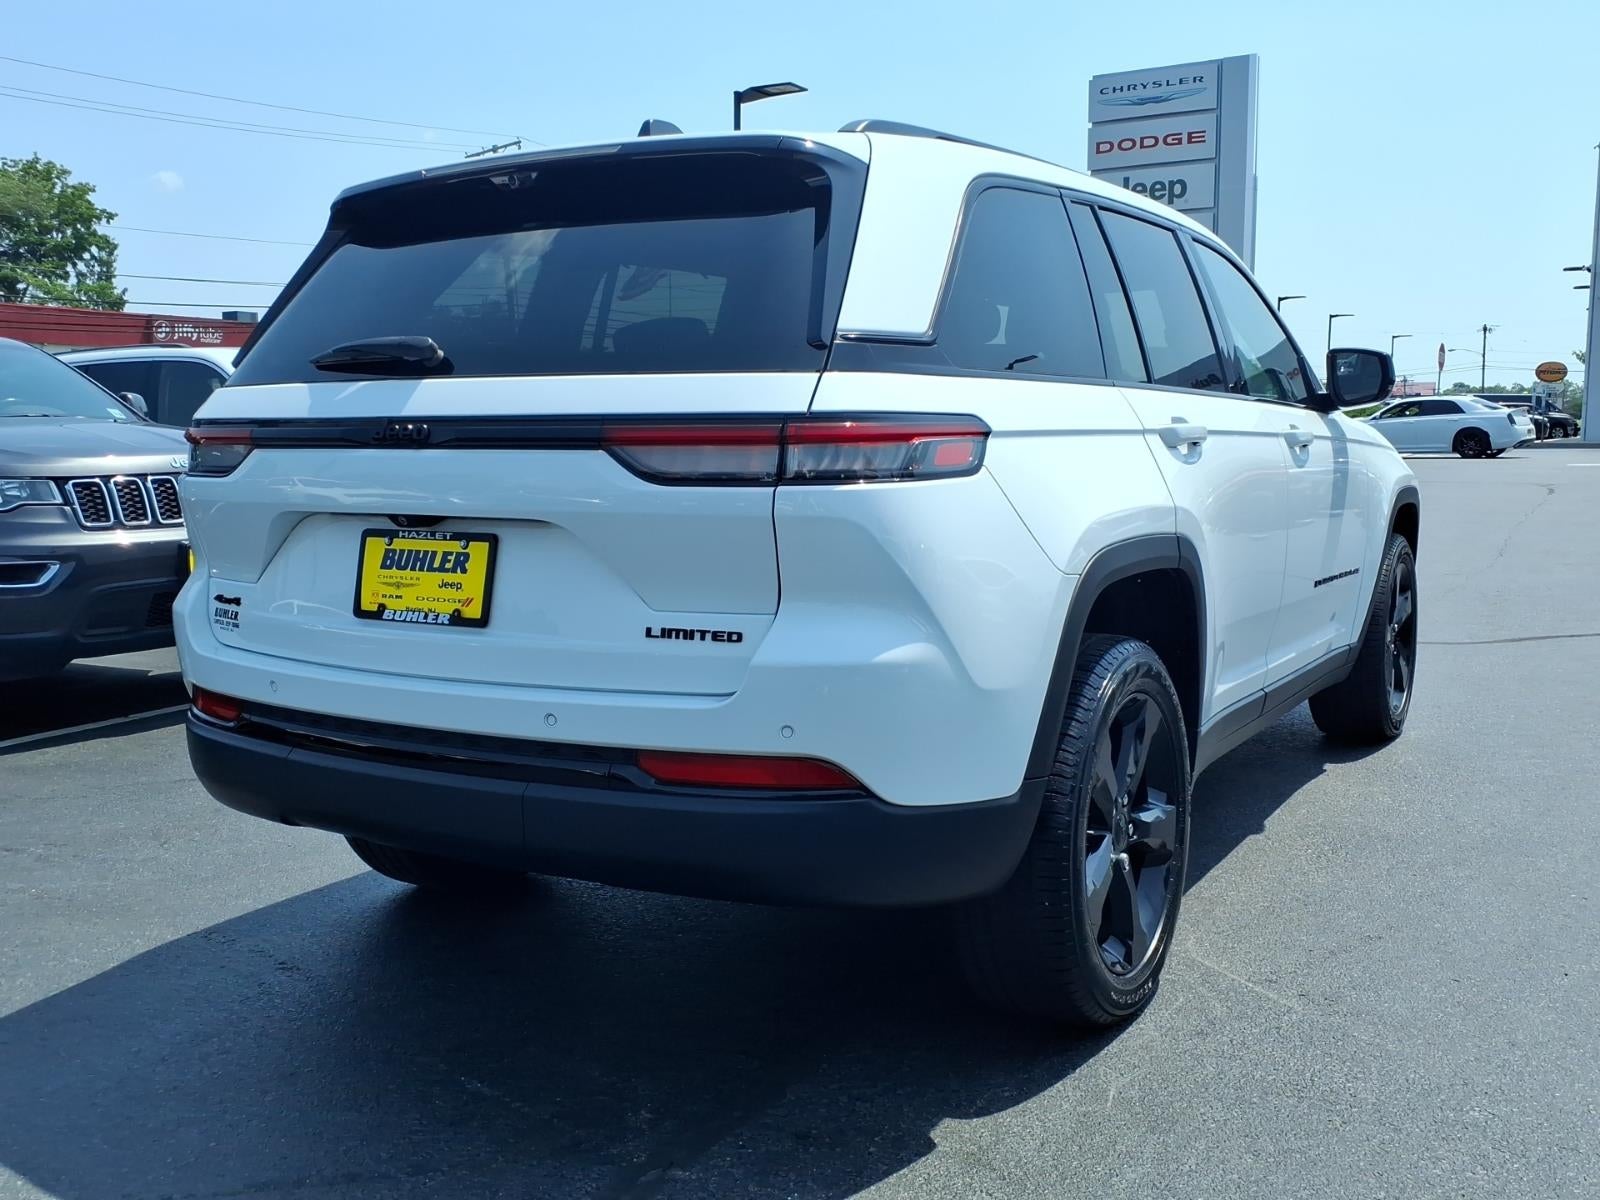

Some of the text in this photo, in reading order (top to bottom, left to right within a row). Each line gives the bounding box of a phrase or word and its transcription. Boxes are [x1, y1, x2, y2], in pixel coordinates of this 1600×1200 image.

[1099, 75, 1205, 95] CHRYSLER
[1095, 129, 1207, 155] DODGE
[399, 530, 454, 540] HAZLET
[380, 547, 471, 575] BUHLER
[377, 574, 421, 582] CHRYSLER
[438, 578, 463, 592] Jeep
[415, 595, 466, 604] DODGE
[382, 609, 450, 624] BUHLER
[645, 626, 743, 643] LIMITED
